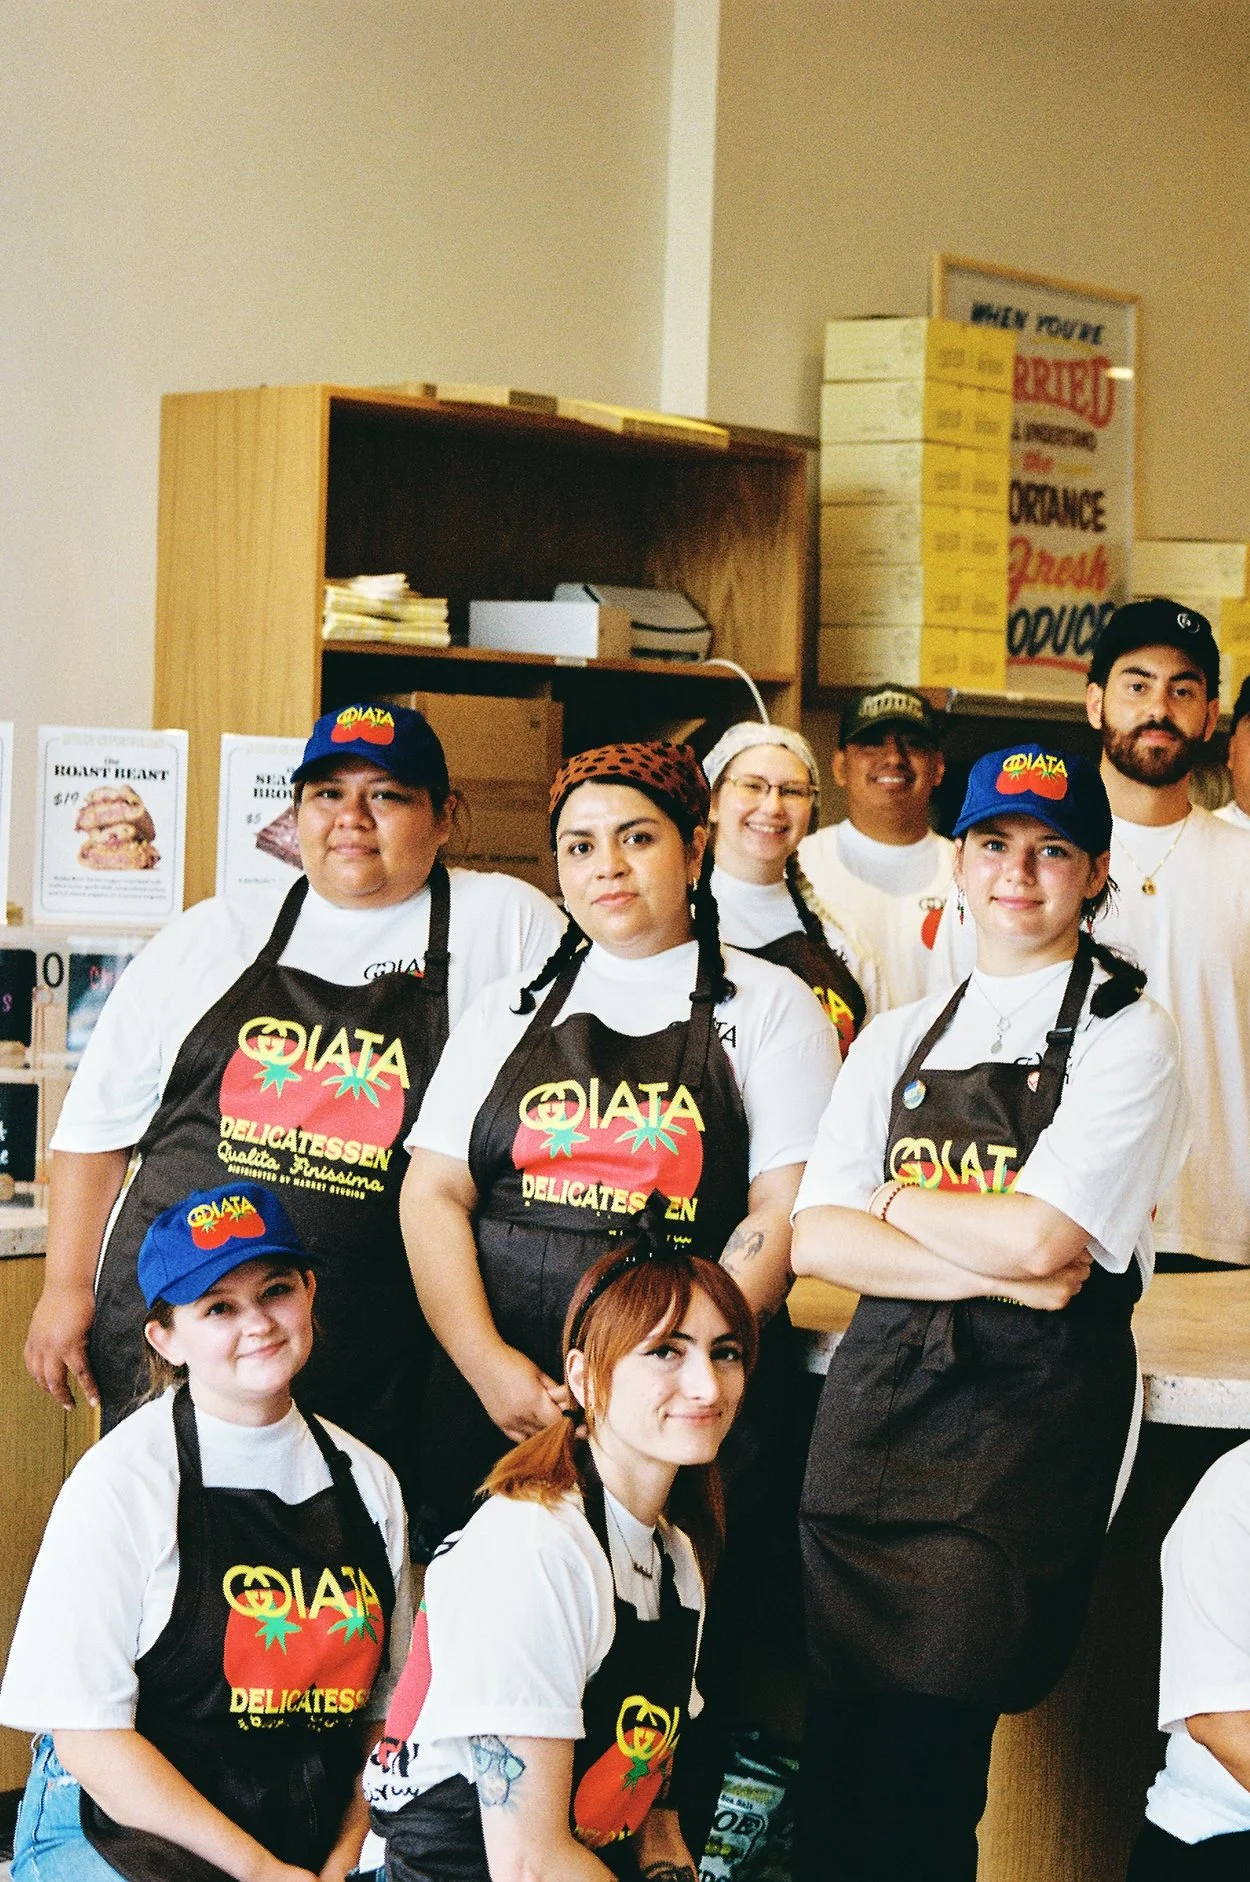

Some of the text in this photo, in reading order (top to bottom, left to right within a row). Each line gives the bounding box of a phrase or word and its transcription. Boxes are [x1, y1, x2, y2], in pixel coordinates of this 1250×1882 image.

[970, 302, 1029, 331] WHEN
[1012, 354, 1116, 430] RRIED
[1008, 478, 1106, 533] ORTANCE
[54, 765, 170, 781] ROAST BEAST
[219, 1114, 394, 1172] DELICATESSEN
[227, 1163, 278, 1183] DISTRIBUTED
[280, 1173, 291, 1185] BY
[521, 1173, 699, 1222] DELICATESEN
